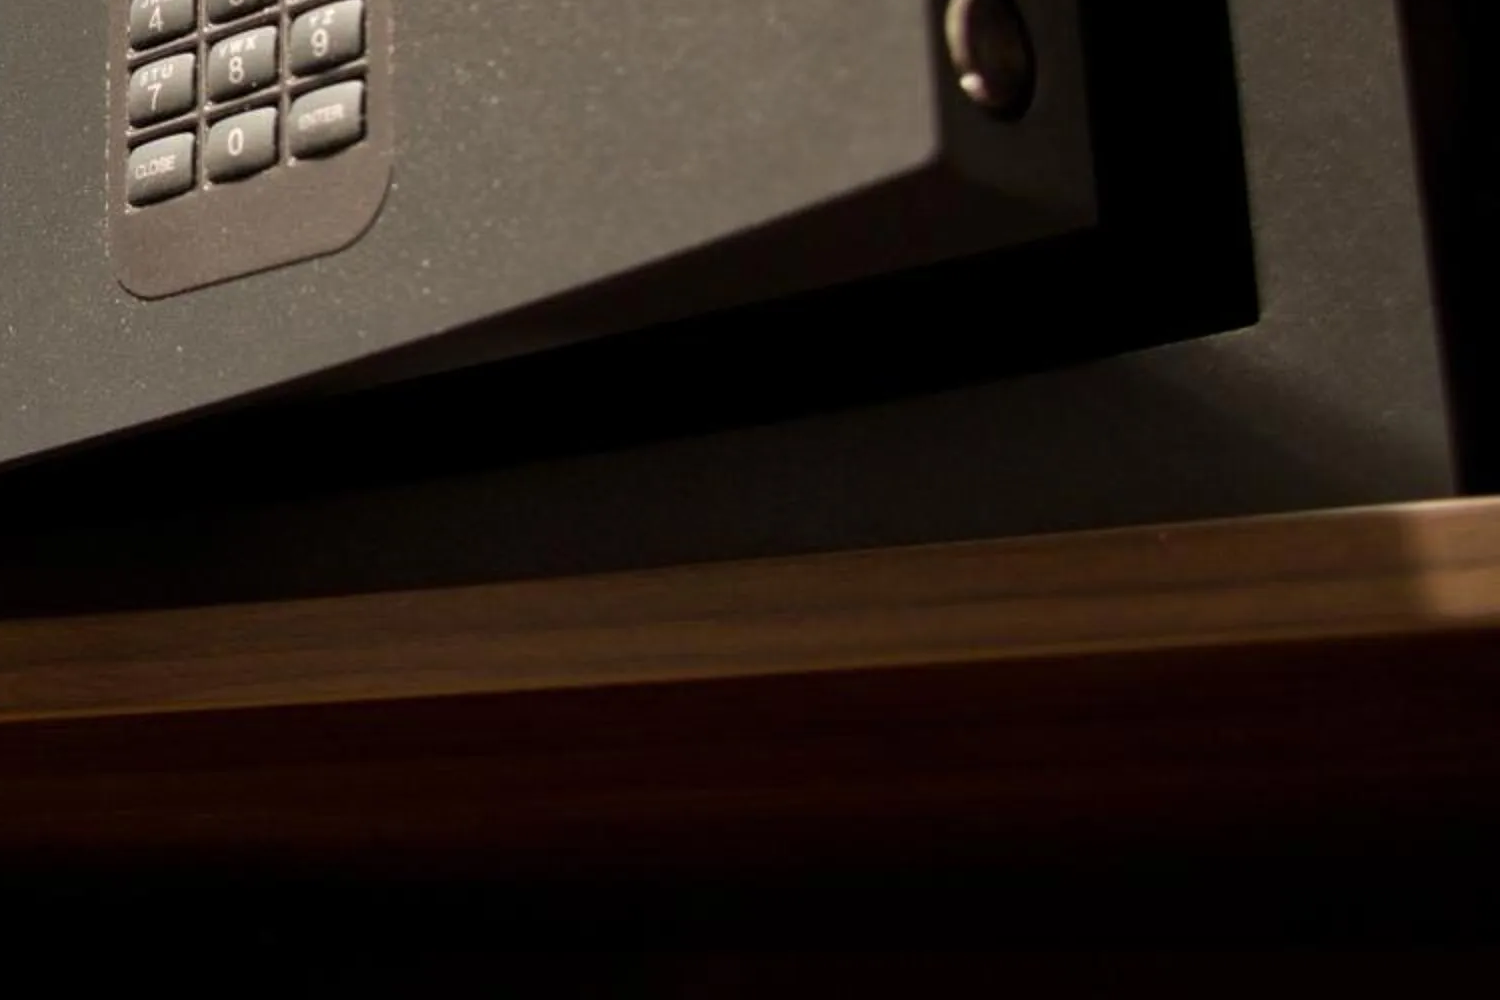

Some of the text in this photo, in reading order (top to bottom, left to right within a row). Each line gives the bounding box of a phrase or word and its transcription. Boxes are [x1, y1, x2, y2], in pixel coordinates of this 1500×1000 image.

[148, 7, 163, 32] 4
[311, 29, 328, 57] 9
[229, 56, 244, 83] 8
[148, 83, 162, 111] 7
[228, 127, 244, 156] 0
[135, 154, 176, 179] CLOSE
